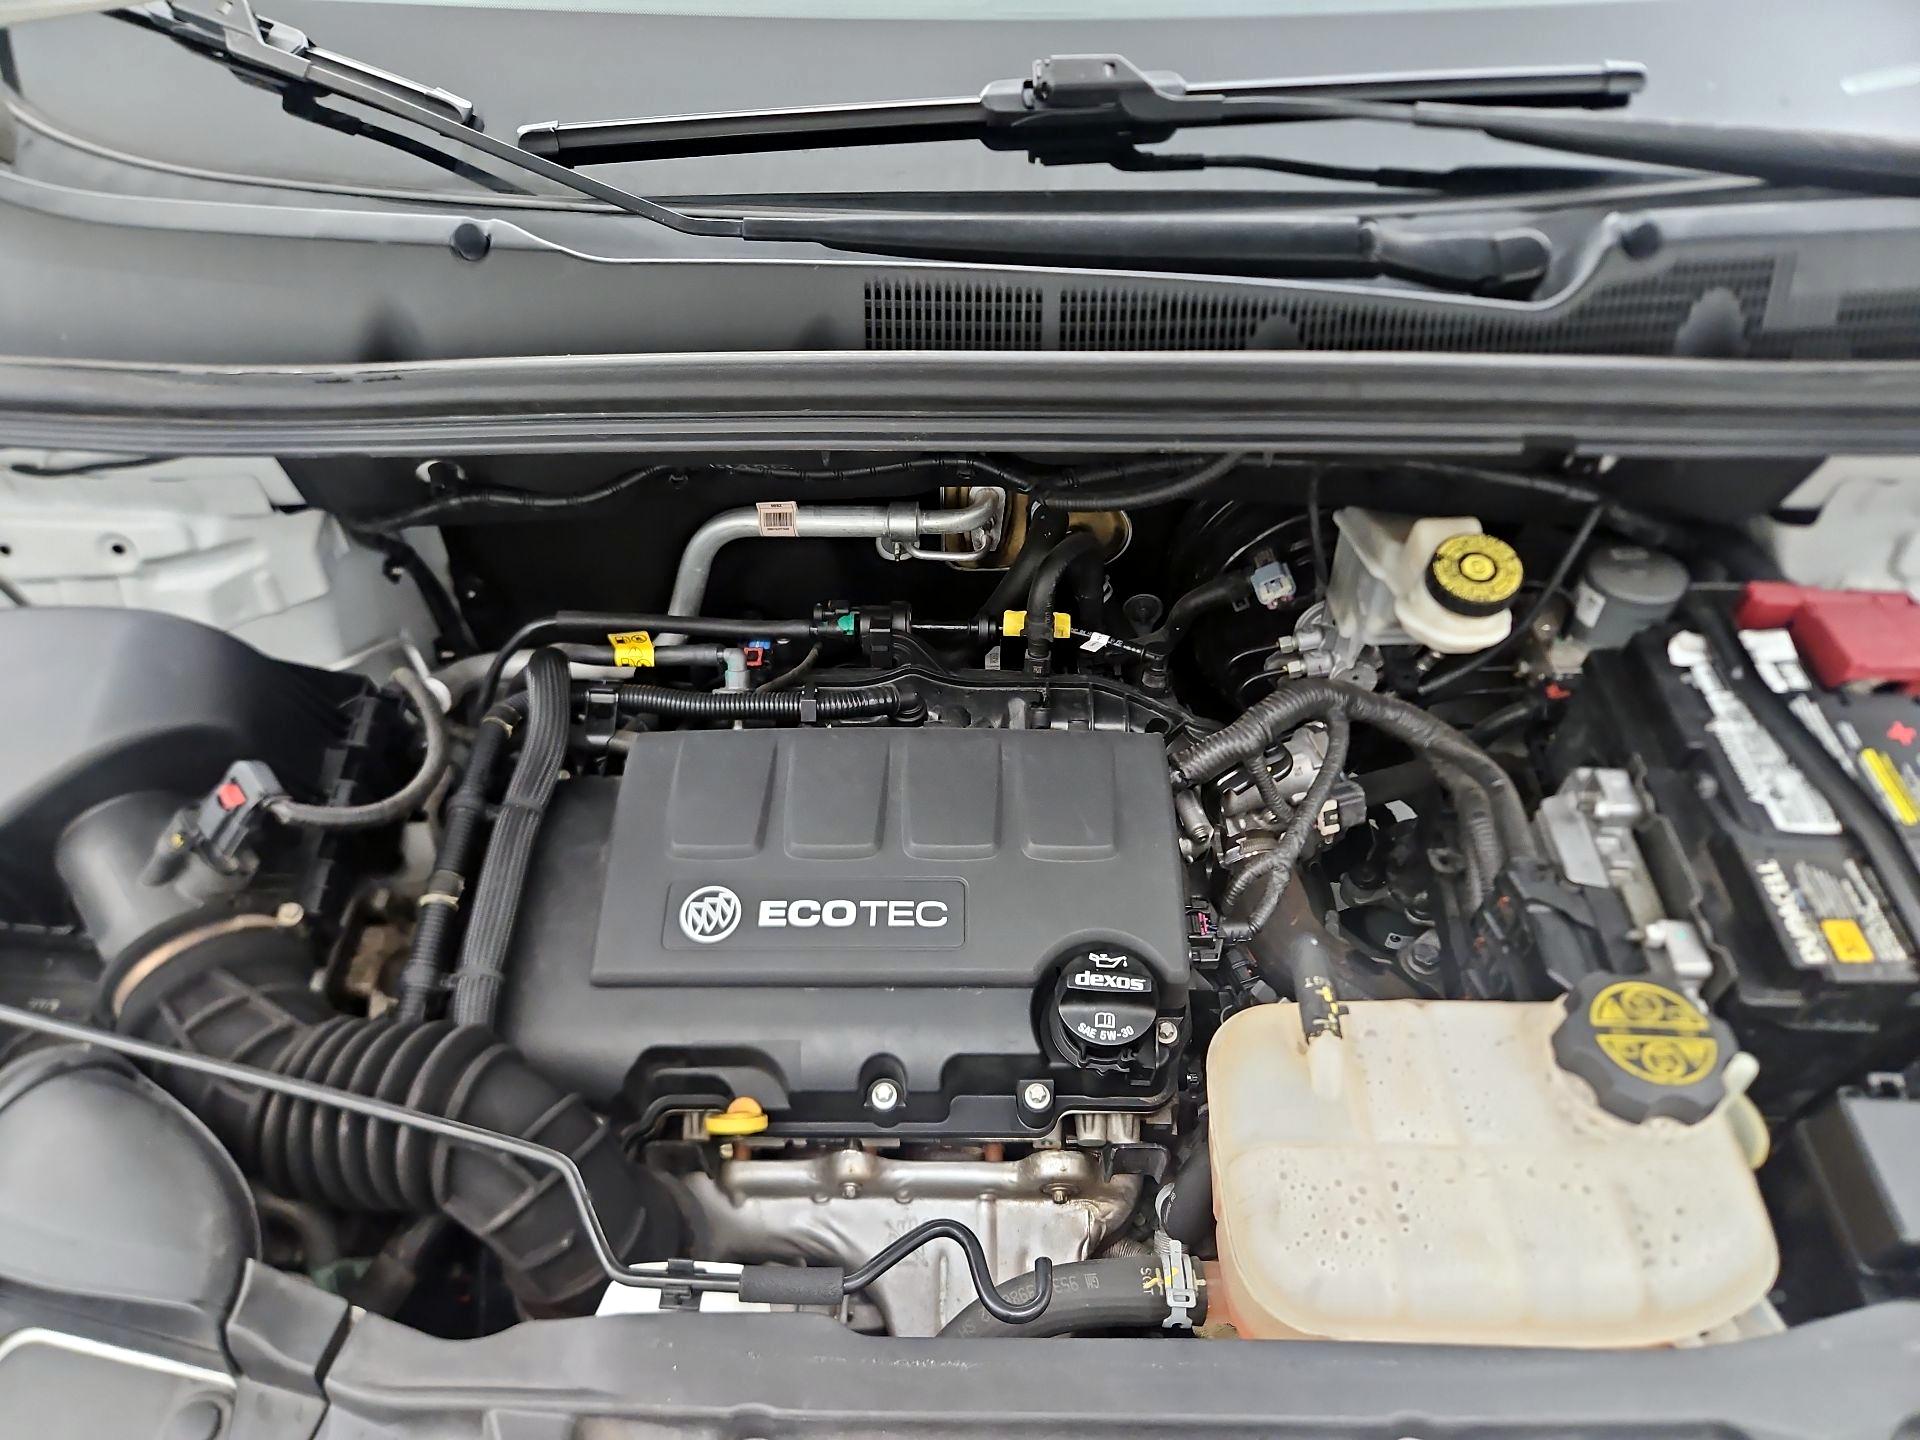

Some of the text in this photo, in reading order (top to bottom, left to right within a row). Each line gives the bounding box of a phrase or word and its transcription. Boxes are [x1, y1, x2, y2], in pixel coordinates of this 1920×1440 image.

[758, 900, 948, 927] ECOTEC
[1074, 970, 1146, 991] dexos
[1077, 1022, 1135, 1041] SAE 5W-30
